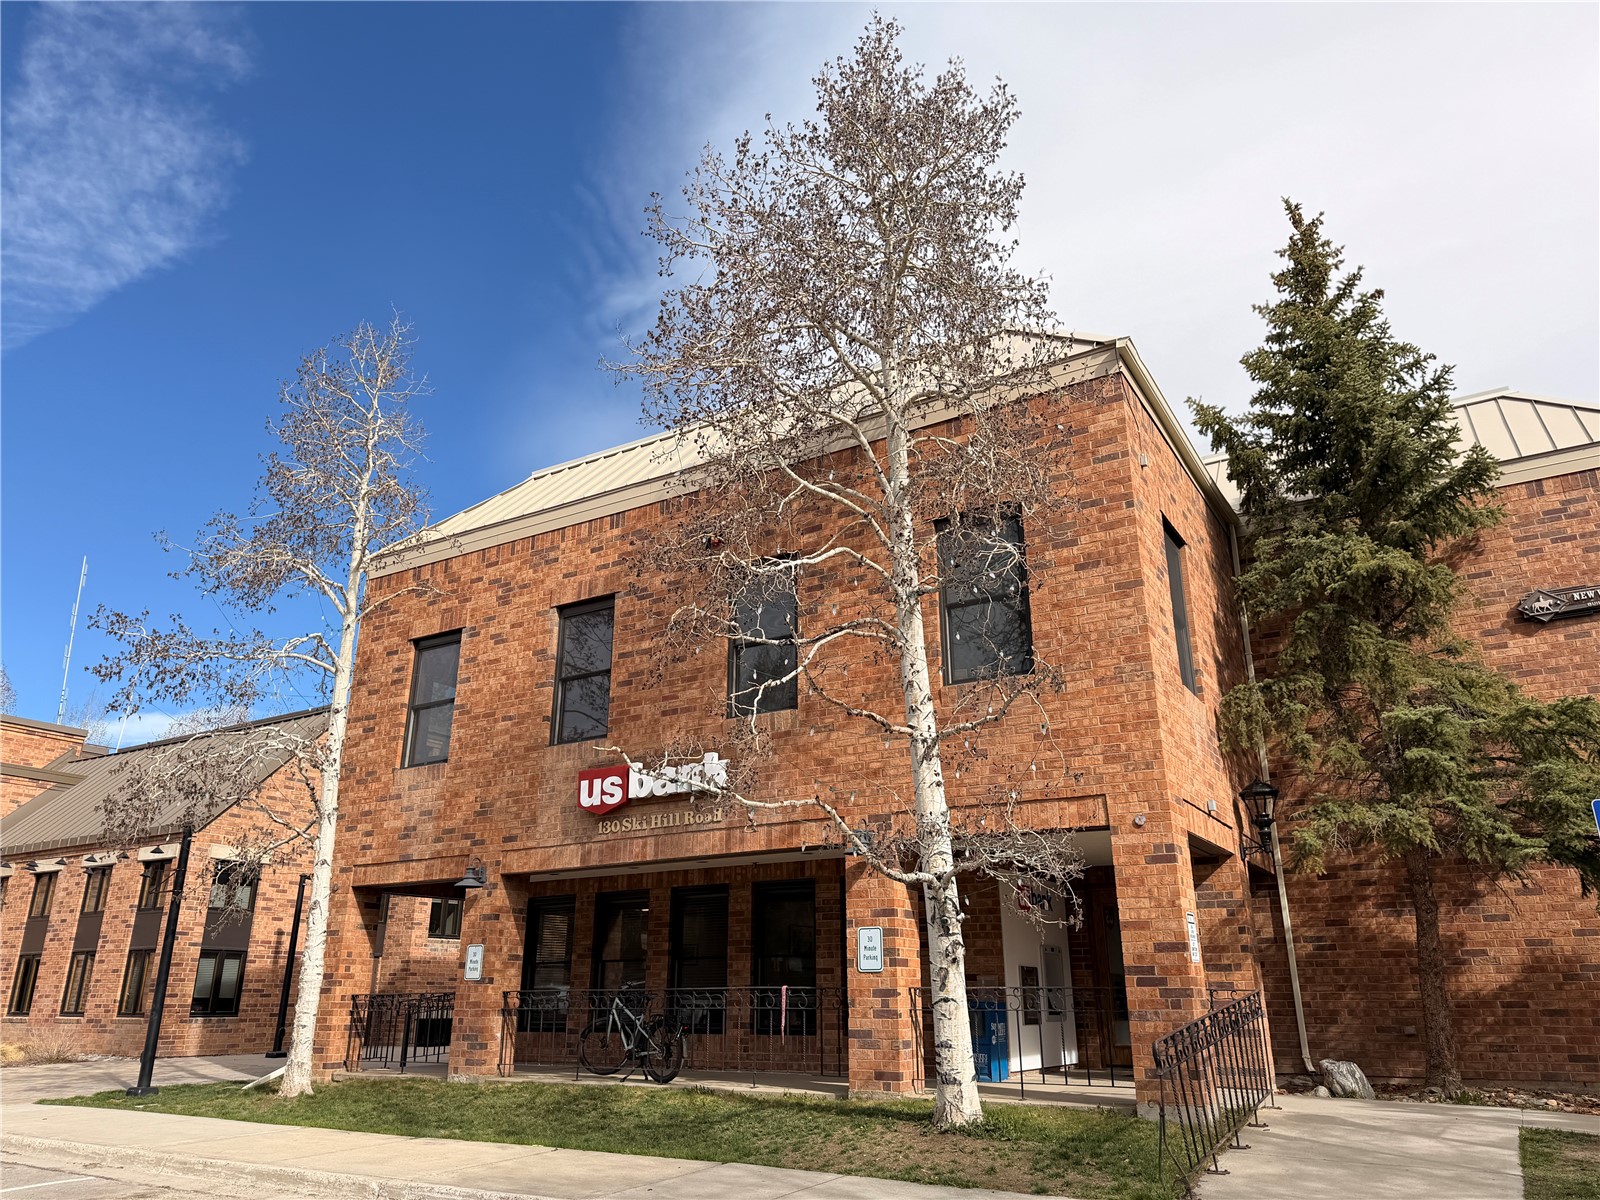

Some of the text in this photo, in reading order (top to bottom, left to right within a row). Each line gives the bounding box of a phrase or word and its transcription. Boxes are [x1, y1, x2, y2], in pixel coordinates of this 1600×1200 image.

[1573, 591, 1595, 601] NEW
[598, 807, 723, 834] 130 Ski Hill Road
[863, 954, 878, 962] Parking
